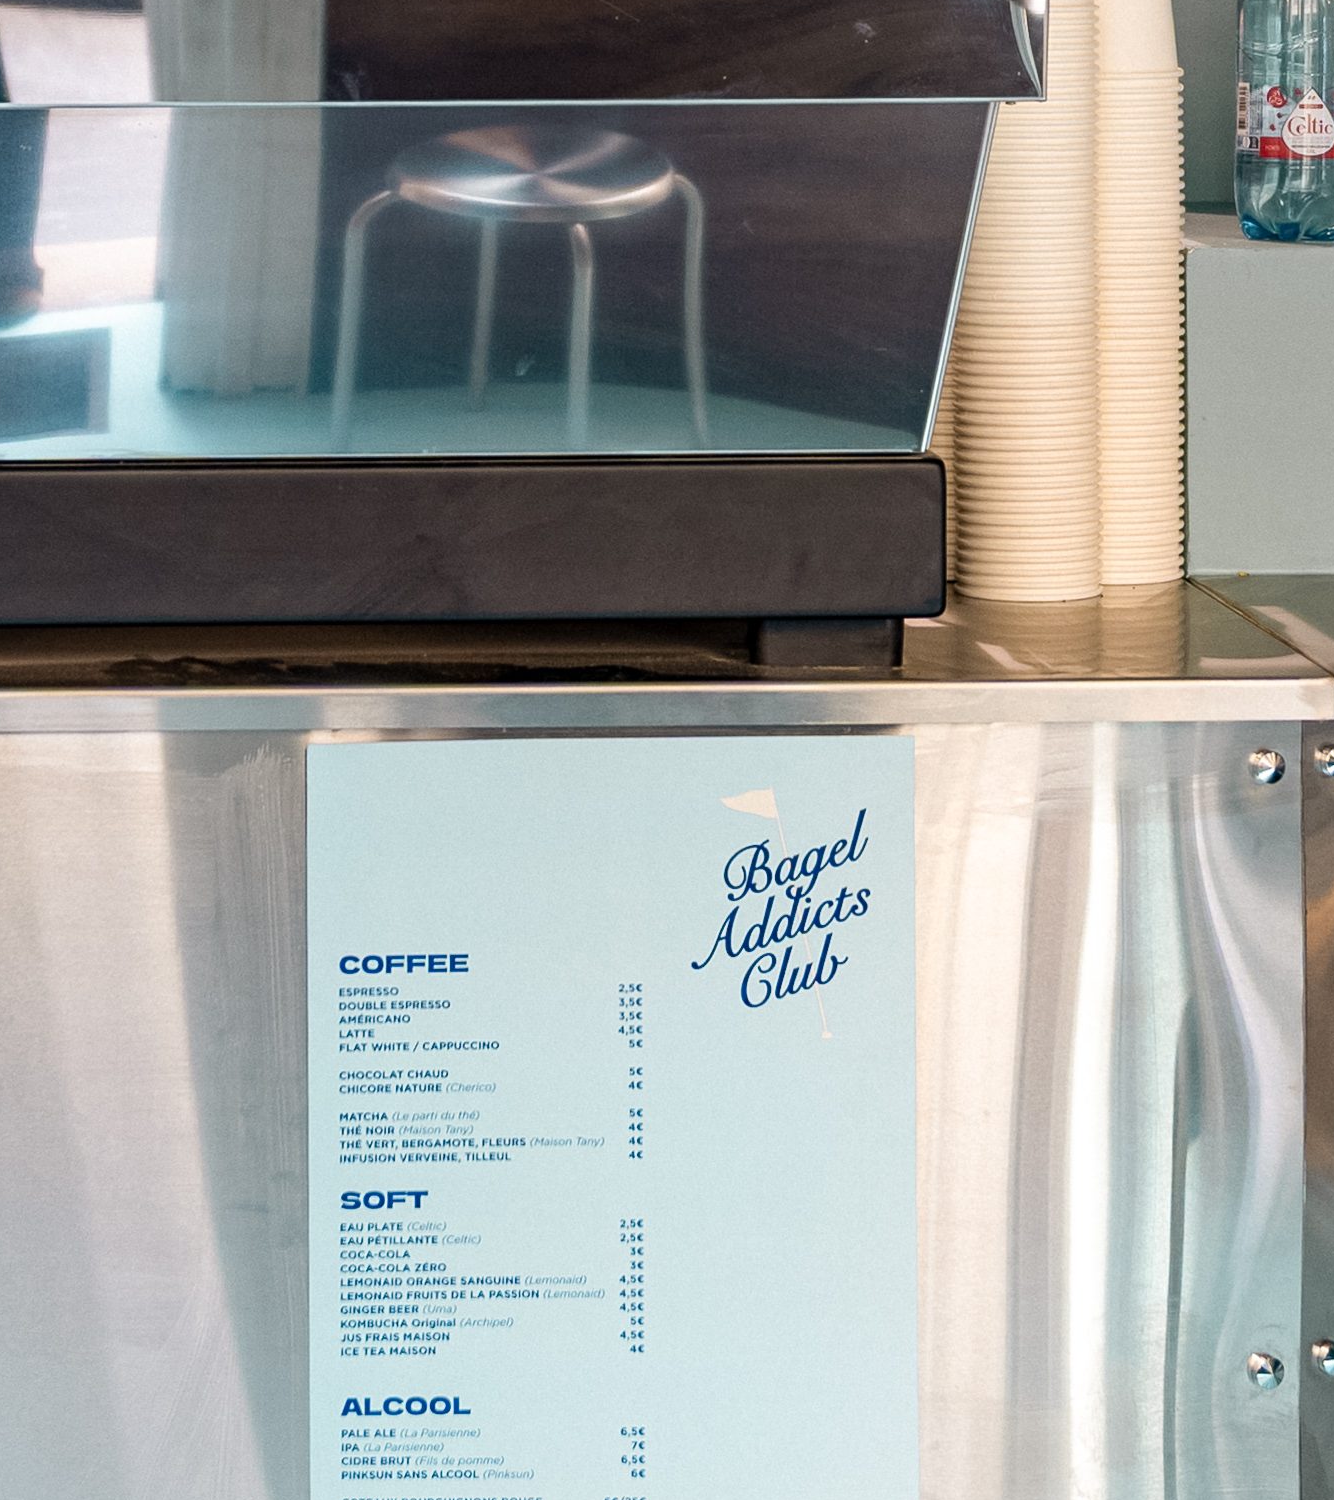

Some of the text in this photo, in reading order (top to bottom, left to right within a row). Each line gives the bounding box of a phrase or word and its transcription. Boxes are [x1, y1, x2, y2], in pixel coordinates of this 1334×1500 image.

[1287, 113, 1333, 136] Celtic
[724, 808, 868, 901] Bagel
[691, 885, 871, 970] Addicts
[339, 953, 469, 975] COFFEE
[741, 932, 848, 1008] Club
[339, 986, 399, 998] ESPRESSO
[338, 1000, 451, 1011] DOUBLE ESPRESSO
[339, 1012, 411, 1026] AMÉRICANO
[339, 1029, 375, 1040] LATTE
[339, 1040, 500, 1053] FLAT WHITE CAPPUCCINO
[339, 1069, 449, 1081] CHOCOLAT CHAUD
[339, 1083, 442, 1095] CHICORE NATURE
[339, 1111, 388, 1123] MATCHA
[339, 1124, 395, 1137] THÉ NOIR
[339, 1137, 526, 1151] THÉ VERT, BERGAMOTE, FLEURS
[339, 1151, 512, 1165] INFUSION VERVEINE, TILLEUL
[340, 1190, 429, 1210] SOFT
[340, 1221, 403, 1233] EAU PLATE
[340, 1234, 438, 1248] EAU PÉTILLANTE
[340, 1249, 411, 1261] COCA-COLA
[340, 1275, 521, 1289] LEMONAID ORANGE SANGUINE
[340, 1304, 419, 1316] GINGER BEER
[340, 1318, 456, 1330] KOMBUCHA Original
[340, 1331, 450, 1344] JUS FRAIS MAISON
[340, 1346, 436, 1358] ICE TEA MAISON
[341, 1396, 471, 1417] ALCOOL
[341, 1429, 396, 1439] PALE ALE
[341, 1443, 360, 1453] IPA
[341, 1455, 411, 1467] CIDRE BRUT
[341, 1469, 479, 1481] PINKSUN SANS ALCOOL
